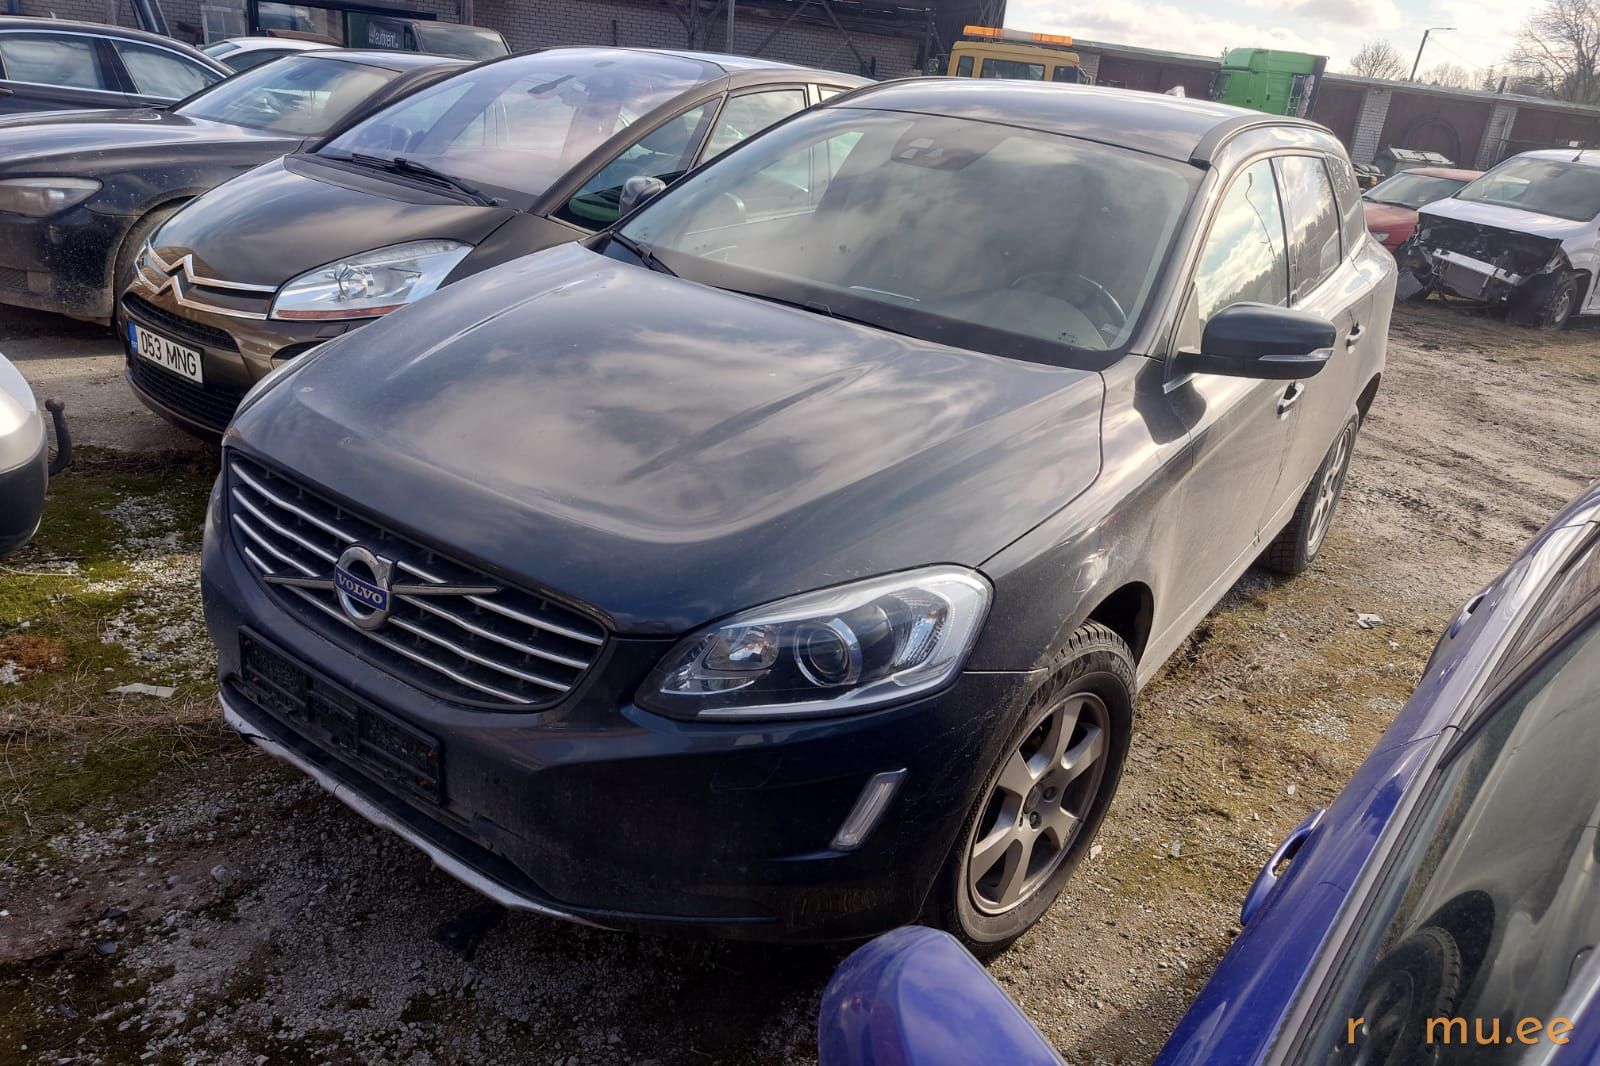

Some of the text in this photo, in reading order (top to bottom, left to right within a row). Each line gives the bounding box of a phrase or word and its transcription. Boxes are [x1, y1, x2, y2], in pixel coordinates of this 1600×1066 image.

[141, 331, 197, 376] 053 MNG
[337, 572, 383, 604] VOLVO
